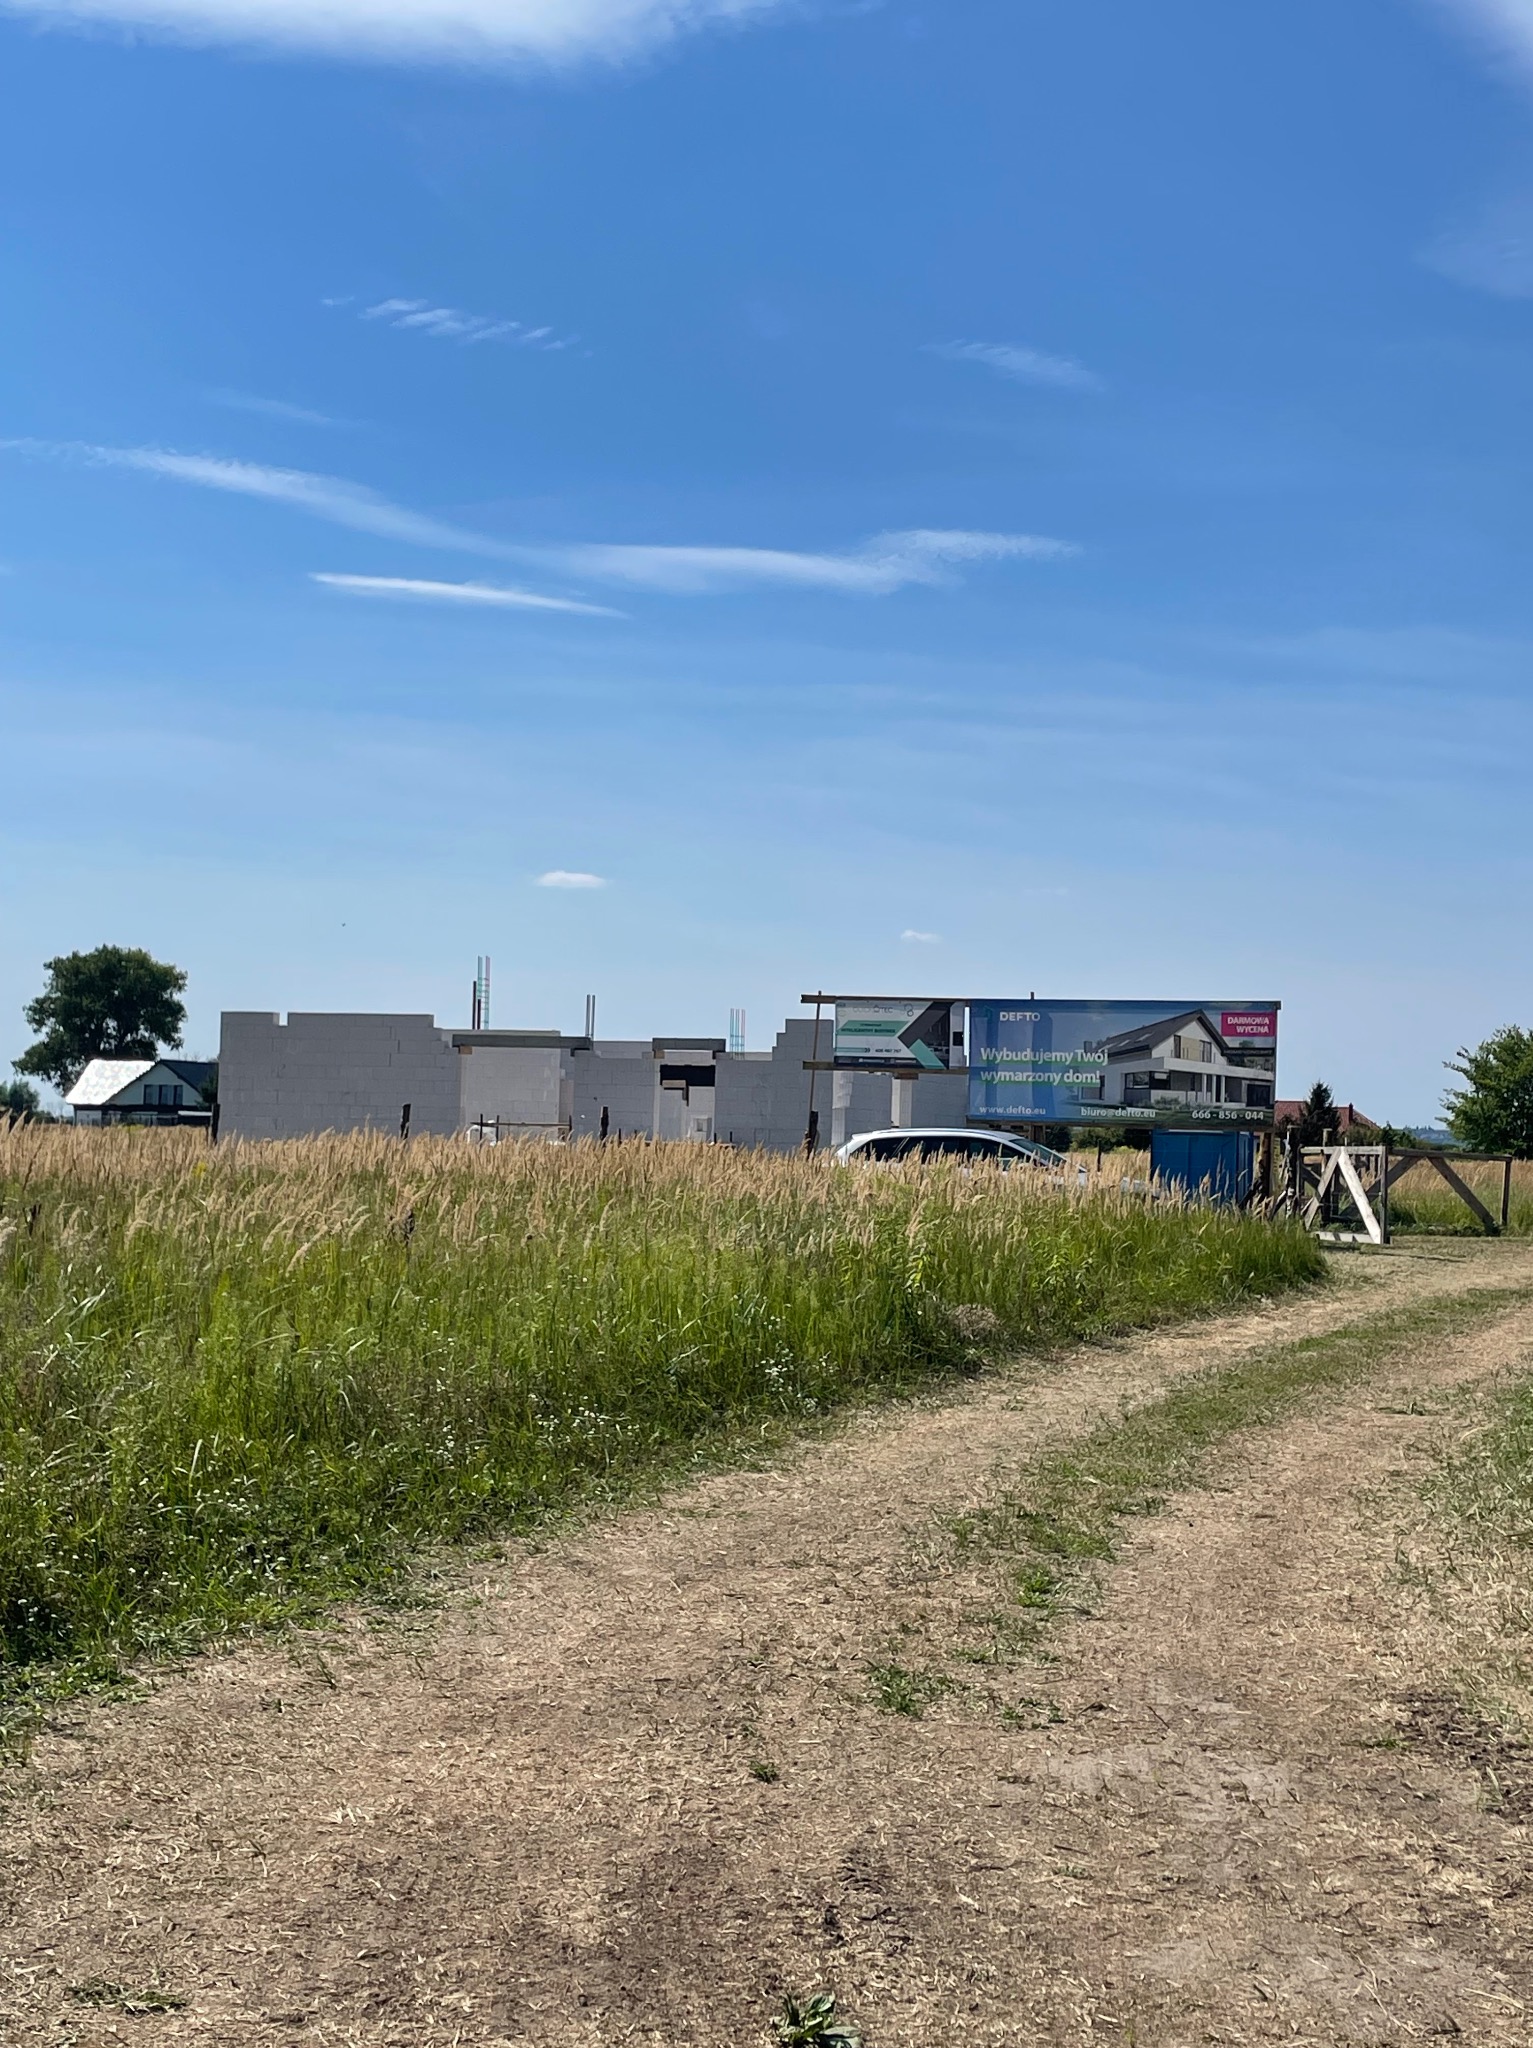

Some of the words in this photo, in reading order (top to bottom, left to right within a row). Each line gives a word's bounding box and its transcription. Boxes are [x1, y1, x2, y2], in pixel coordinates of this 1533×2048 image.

[999, 1012, 1041, 1022] DEFTO
[1227, 1016, 1270, 1025] DARMOWA
[1236, 1025, 1269, 1034] WYCENA
[980, 1047, 1074, 1064] Wybudujemy
[1076, 1049, 1109, 1066] Twój
[980, 1071, 1062, 1086] wymarzony
[1063, 1069, 1101, 1083] dom!
[979, 1105, 1046, 1115] www.defto.eu
[1080, 1106, 1156, 1118] biuro@defto.eu
[1191, 1110, 1211, 1119] 666
[1218, 1110, 1238, 1120] 856
[1246, 1111, 1264, 1120] 044
